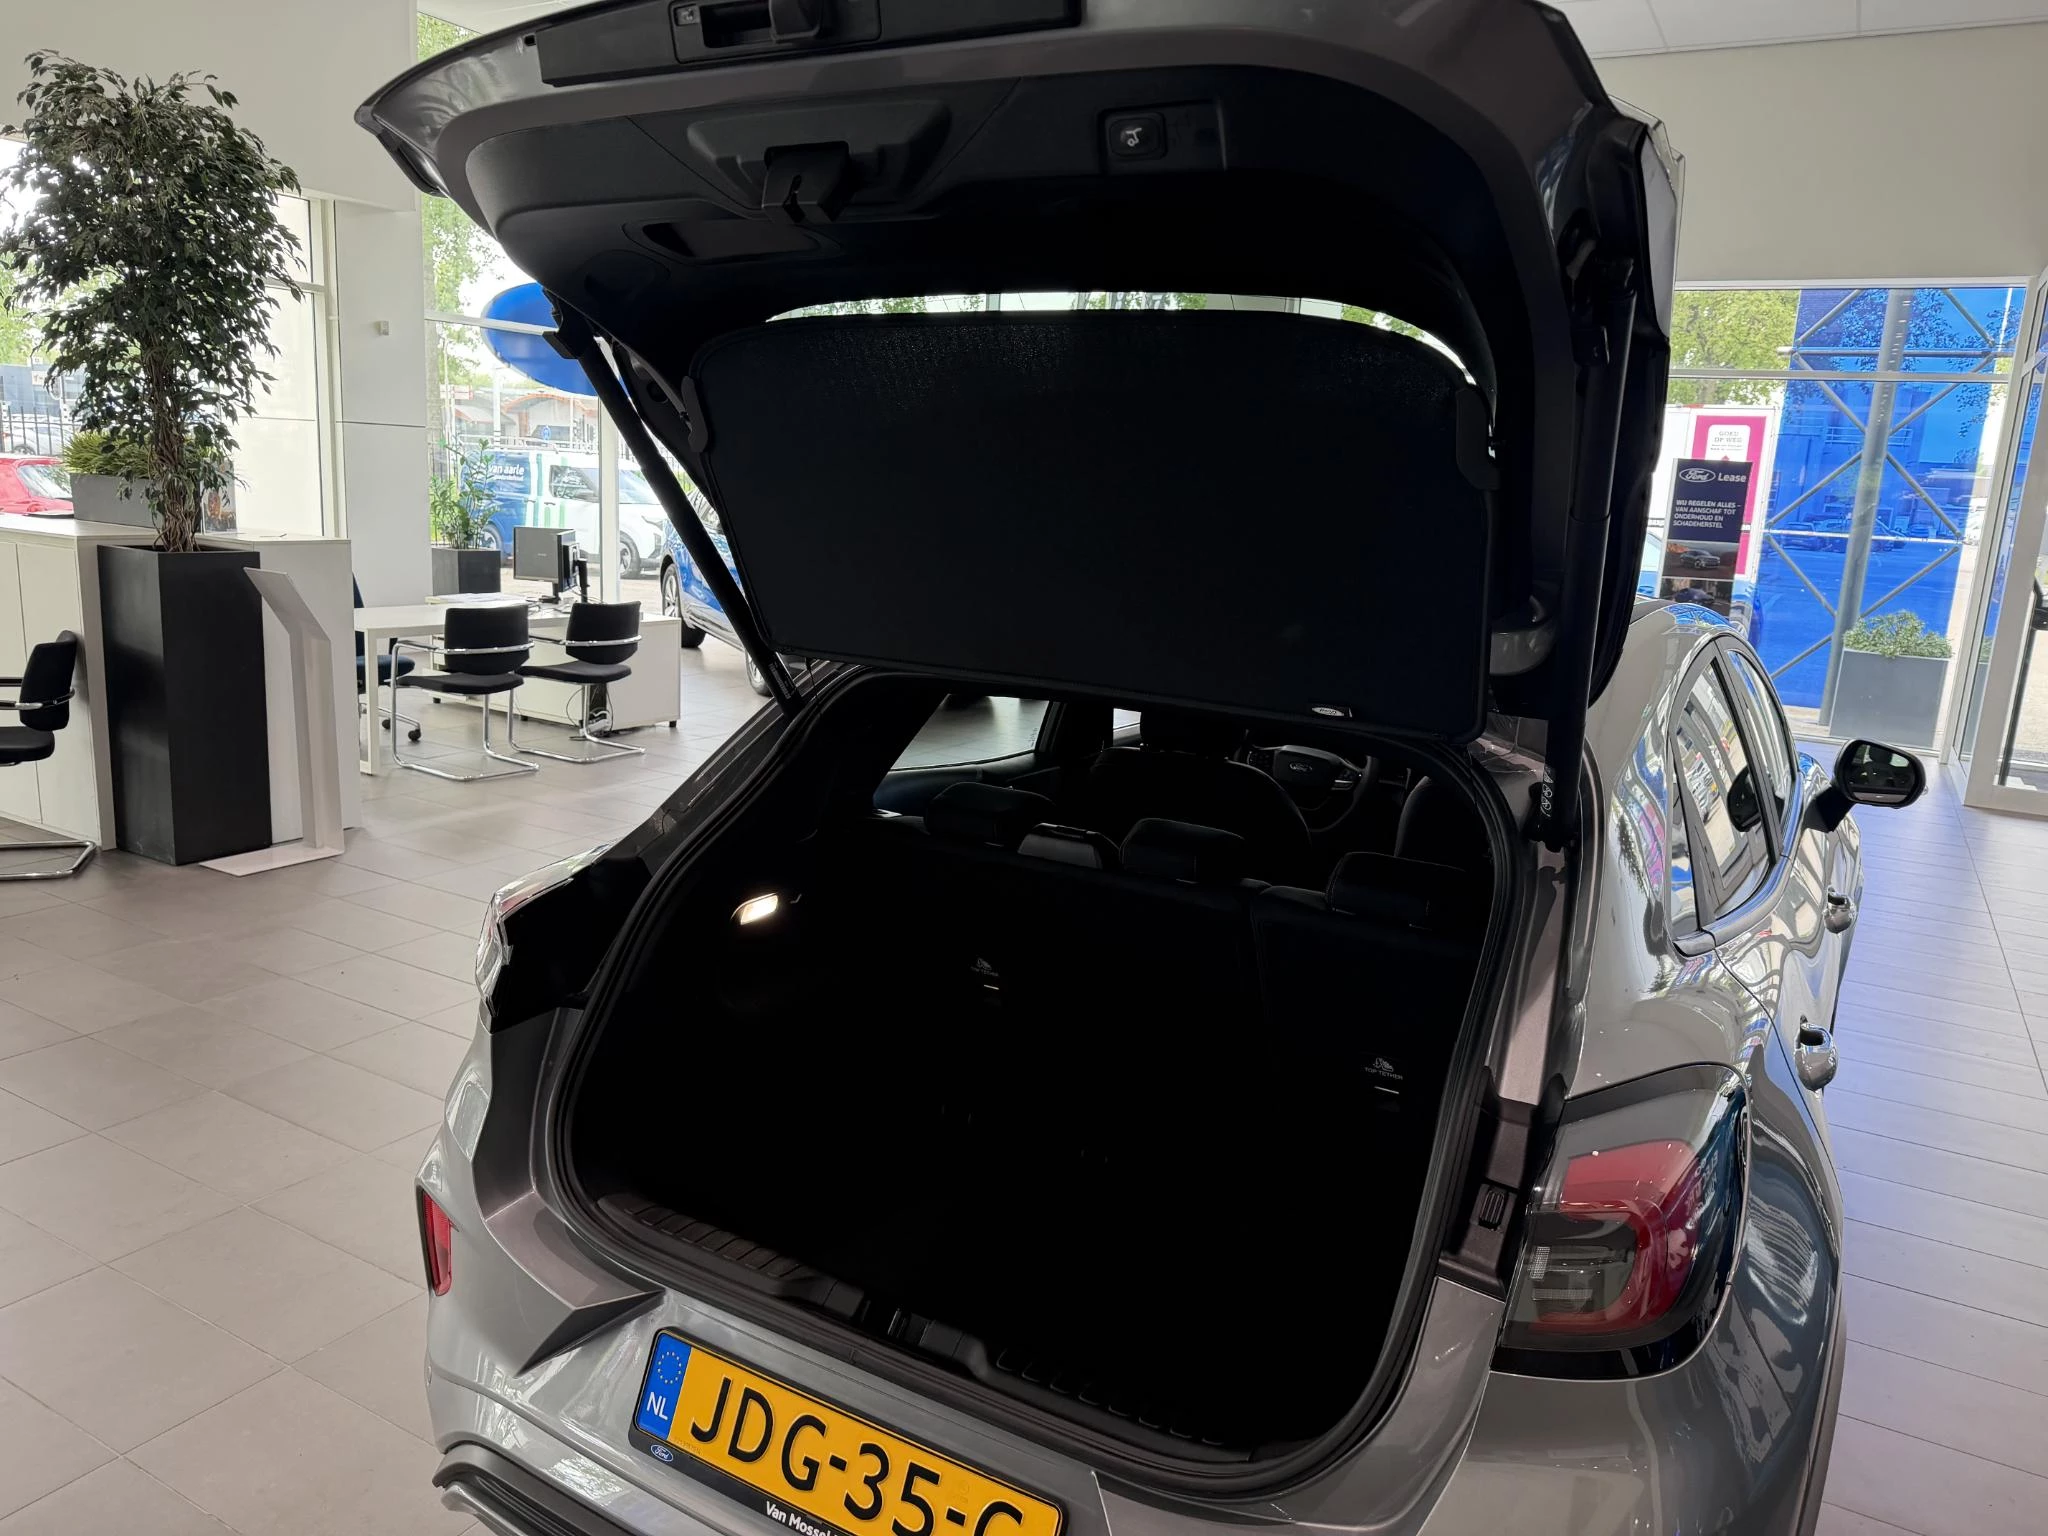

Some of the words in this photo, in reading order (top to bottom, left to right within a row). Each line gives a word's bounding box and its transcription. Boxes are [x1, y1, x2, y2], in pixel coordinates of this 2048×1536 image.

[1683, 469, 1711, 481] Ford
[1718, 472, 1747, 482] Lease
[1688, 500, 1716, 508] REGELEN
[1674, 513, 1714, 521] ONDERHOUD
[1673, 520, 1723, 529] SCHADEHERSTEL
[646, 1391, 669, 1420] NL
[653, 1445, 671, 1460] Ford
[766, 1501, 787, 1523] Van
